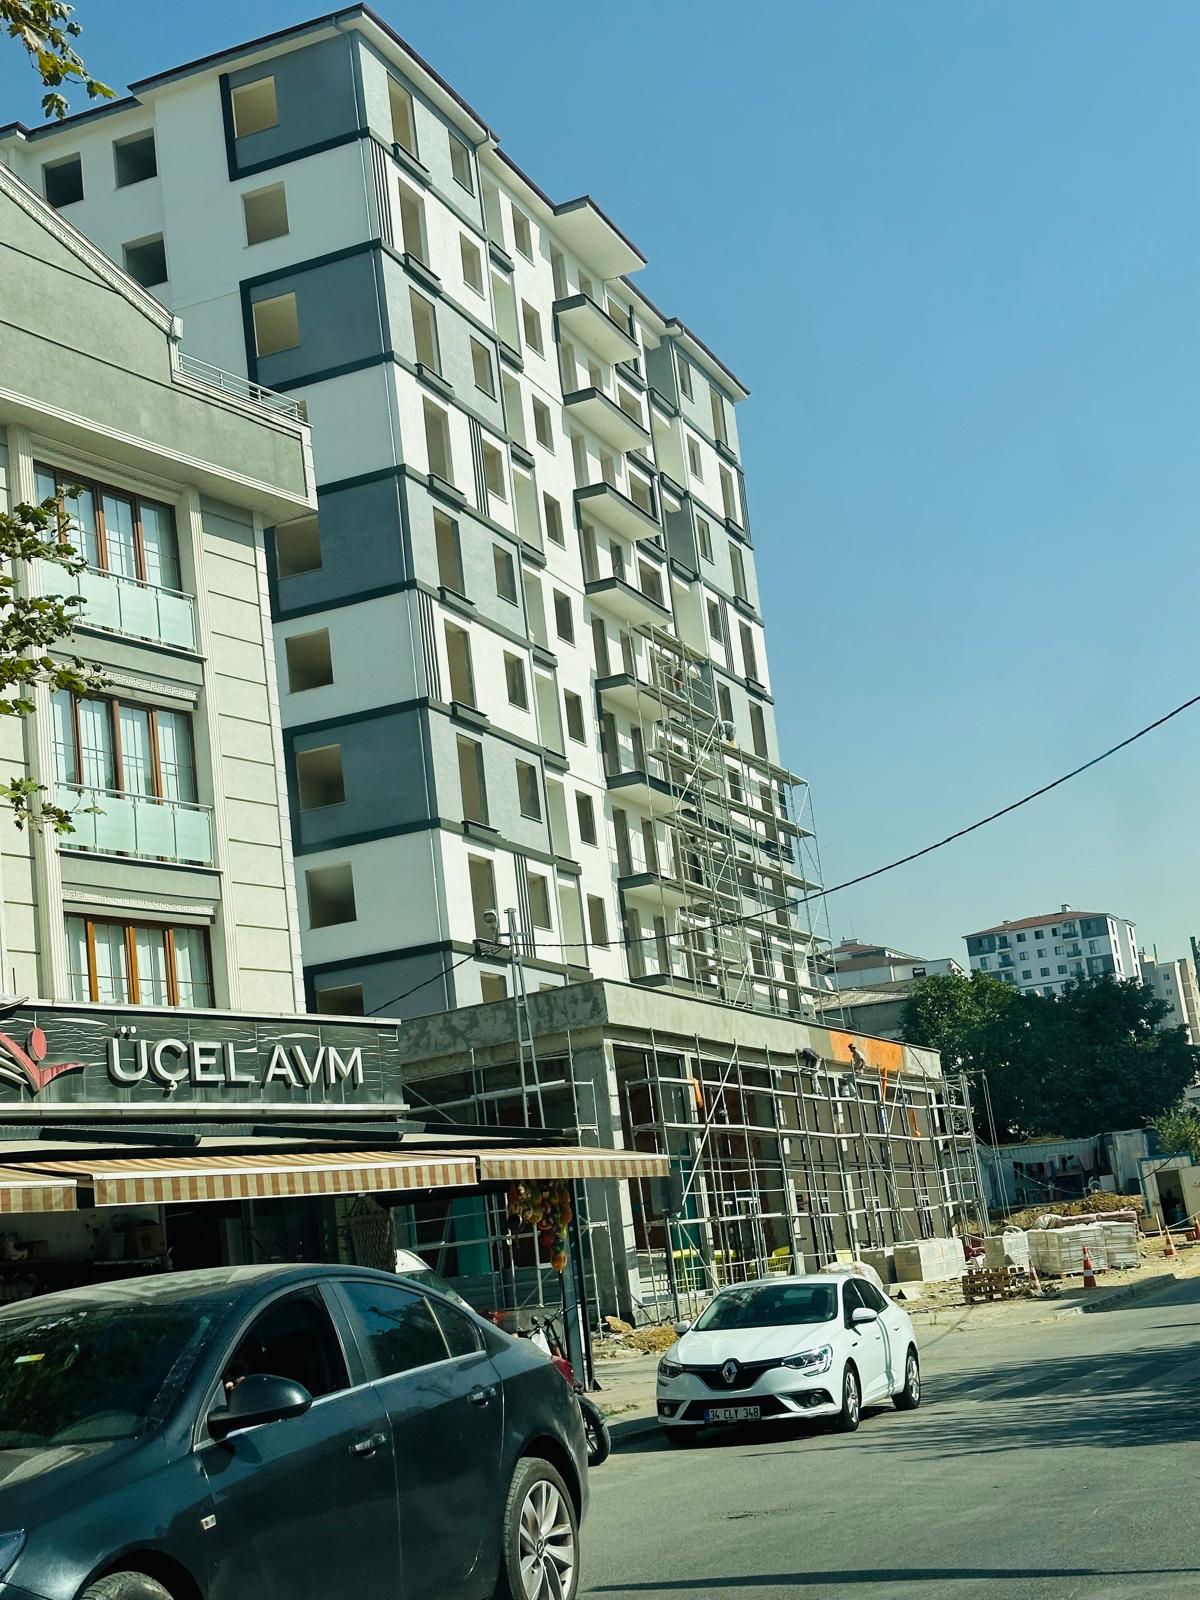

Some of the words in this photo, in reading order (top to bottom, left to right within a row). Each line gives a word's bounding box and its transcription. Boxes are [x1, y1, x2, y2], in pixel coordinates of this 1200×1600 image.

[108, 1025, 256, 1094] ÜÇEL
[261, 1044, 364, 1088] AVM
[710, 1410, 720, 1420] 34
[723, 1408, 739, 1420] CLY
[743, 1407, 759, 1418] 348
